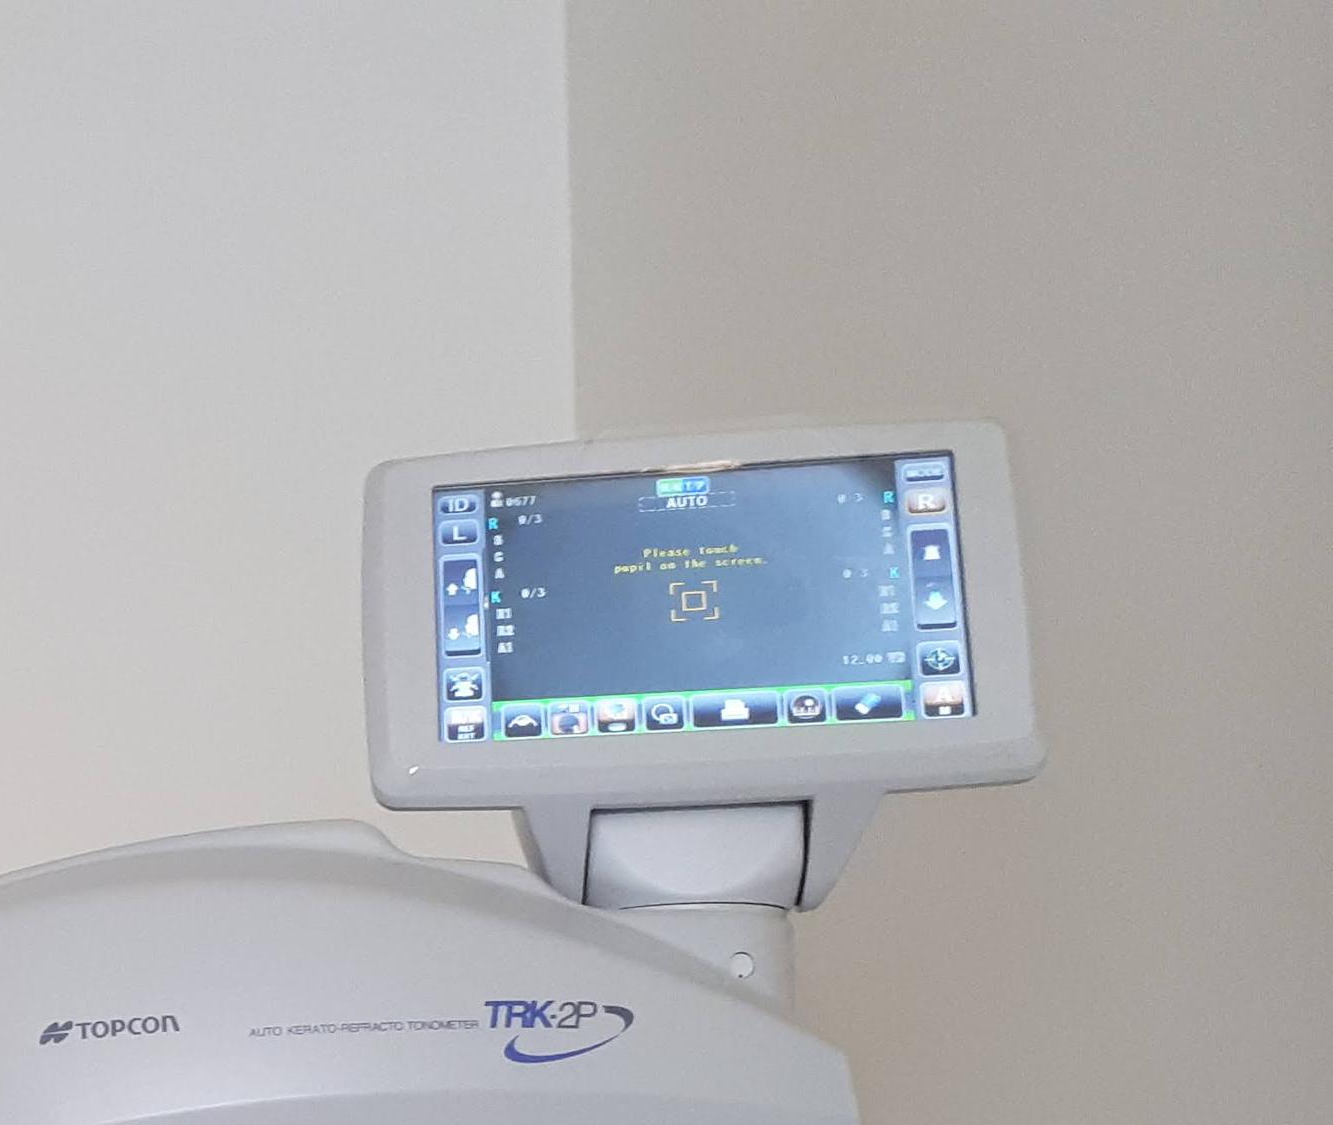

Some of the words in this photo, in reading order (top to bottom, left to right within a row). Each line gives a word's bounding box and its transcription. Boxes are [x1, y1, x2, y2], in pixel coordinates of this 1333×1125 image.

[448, 498, 470, 513] ID
[666, 495, 708, 508] AUTO
[488, 517, 499, 530] R
[452, 525, 467, 541] L
[643, 548, 690, 559] Please
[490, 591, 502, 603] K
[485, 1000, 599, 1029] TRK-2P
[74, 1014, 180, 1040] TOPCON
[249, 1026, 283, 1038] AUTO
[407, 1019, 480, 1032] TONOMETER
